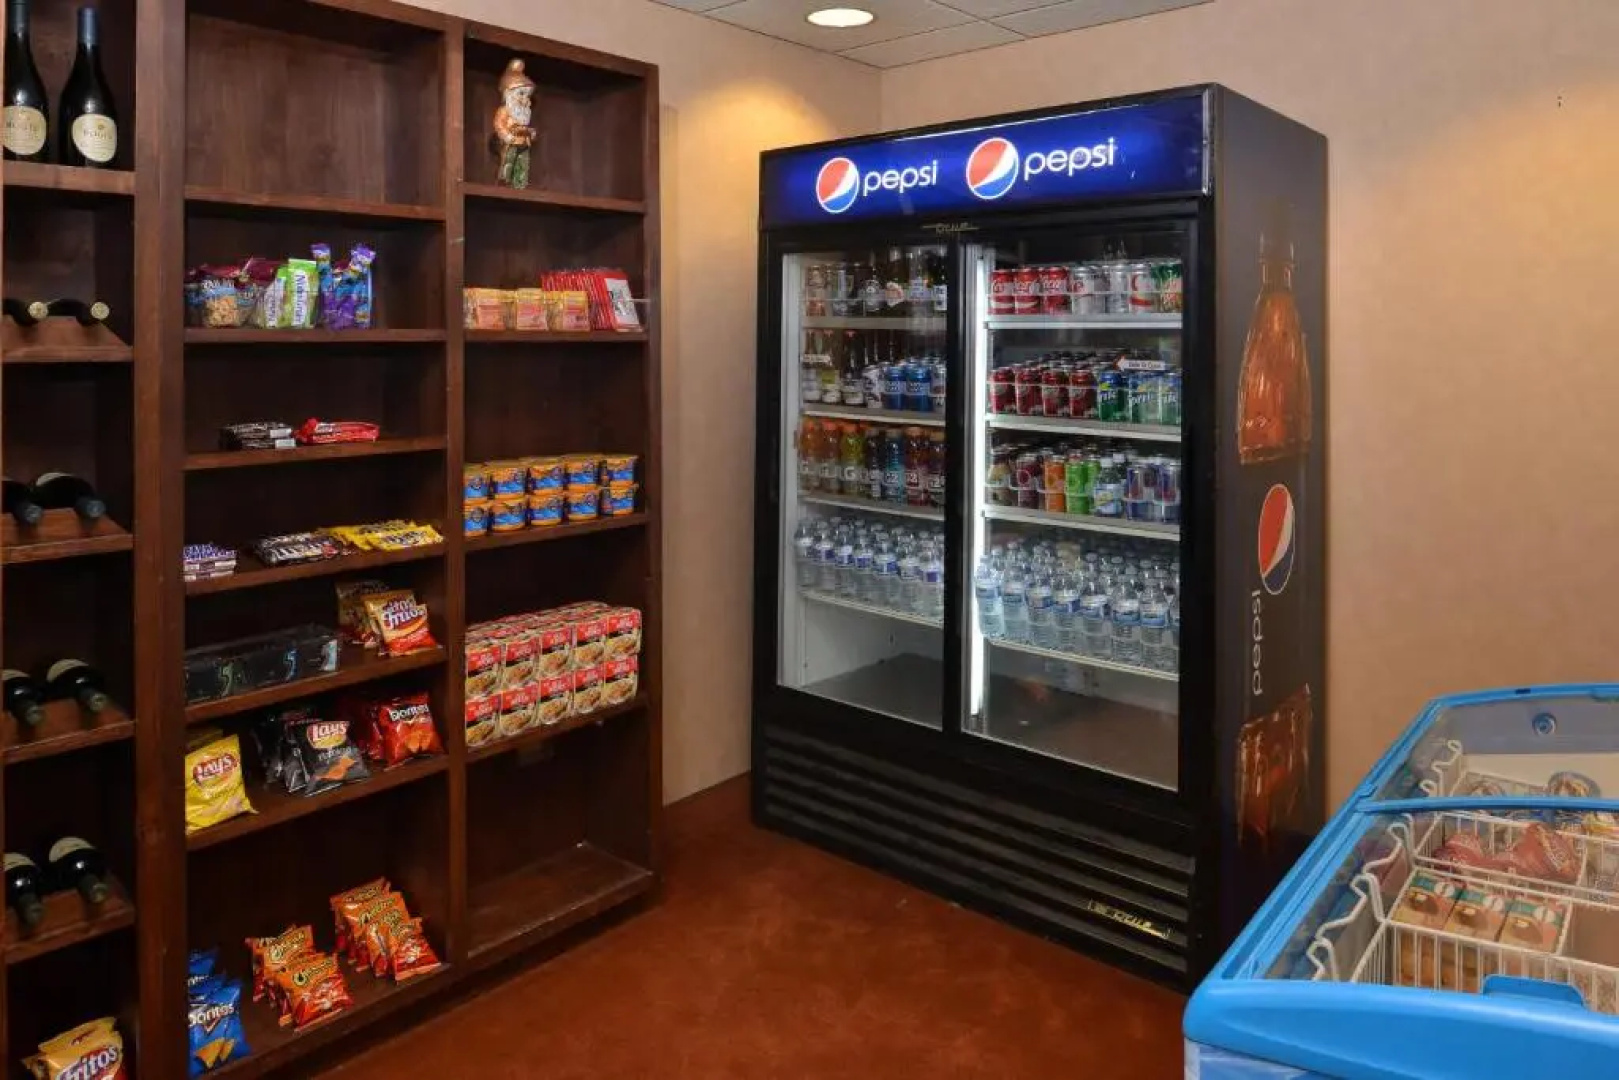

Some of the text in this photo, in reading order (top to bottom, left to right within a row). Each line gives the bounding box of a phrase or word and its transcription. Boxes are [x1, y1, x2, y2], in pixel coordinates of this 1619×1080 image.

[862, 160, 938, 197] pepsi
[1023, 137, 1116, 181] pepsi
[1252, 589, 1263, 696] pepsi
